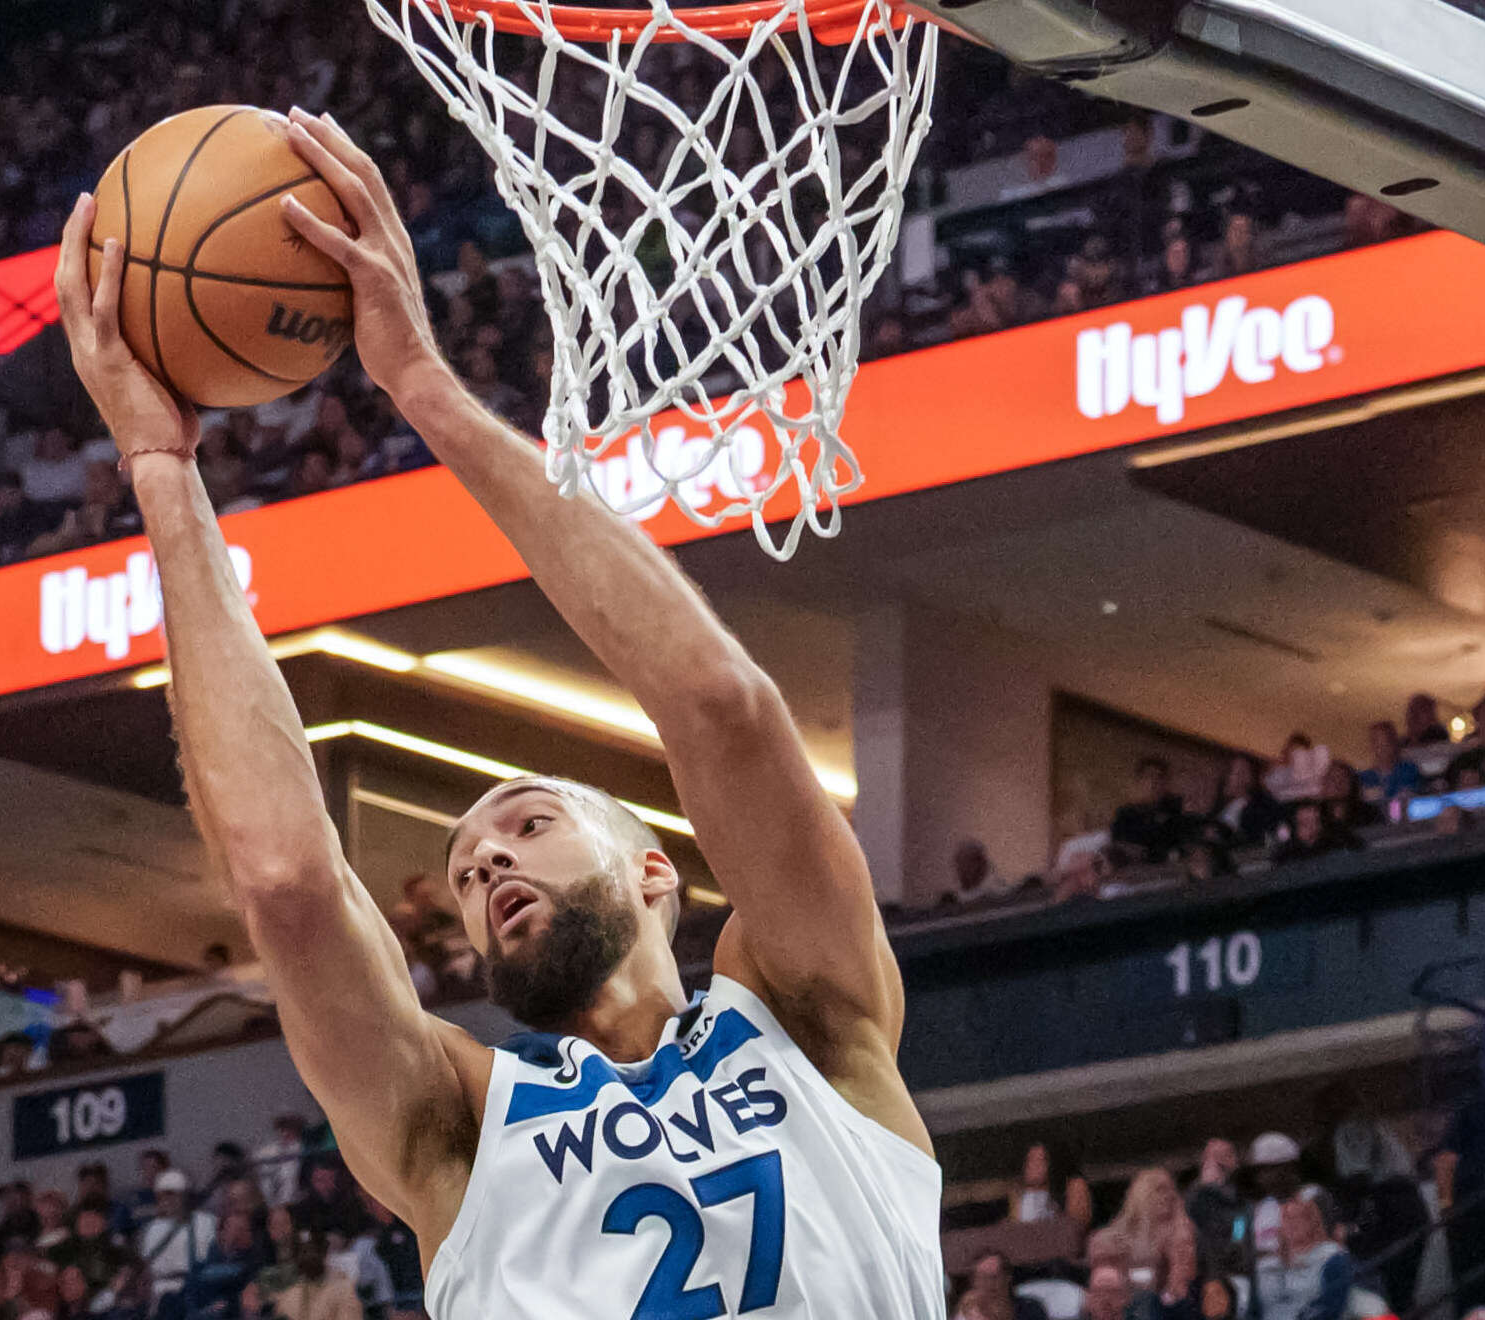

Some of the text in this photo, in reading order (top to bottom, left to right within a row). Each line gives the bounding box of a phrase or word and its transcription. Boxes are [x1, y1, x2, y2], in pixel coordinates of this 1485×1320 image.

[1077, 296, 1335, 424] HyVee
[1165, 931, 1262, 996] 110
[50, 1087, 125, 1143] 109
[533, 1067, 788, 1185] WOLVES
